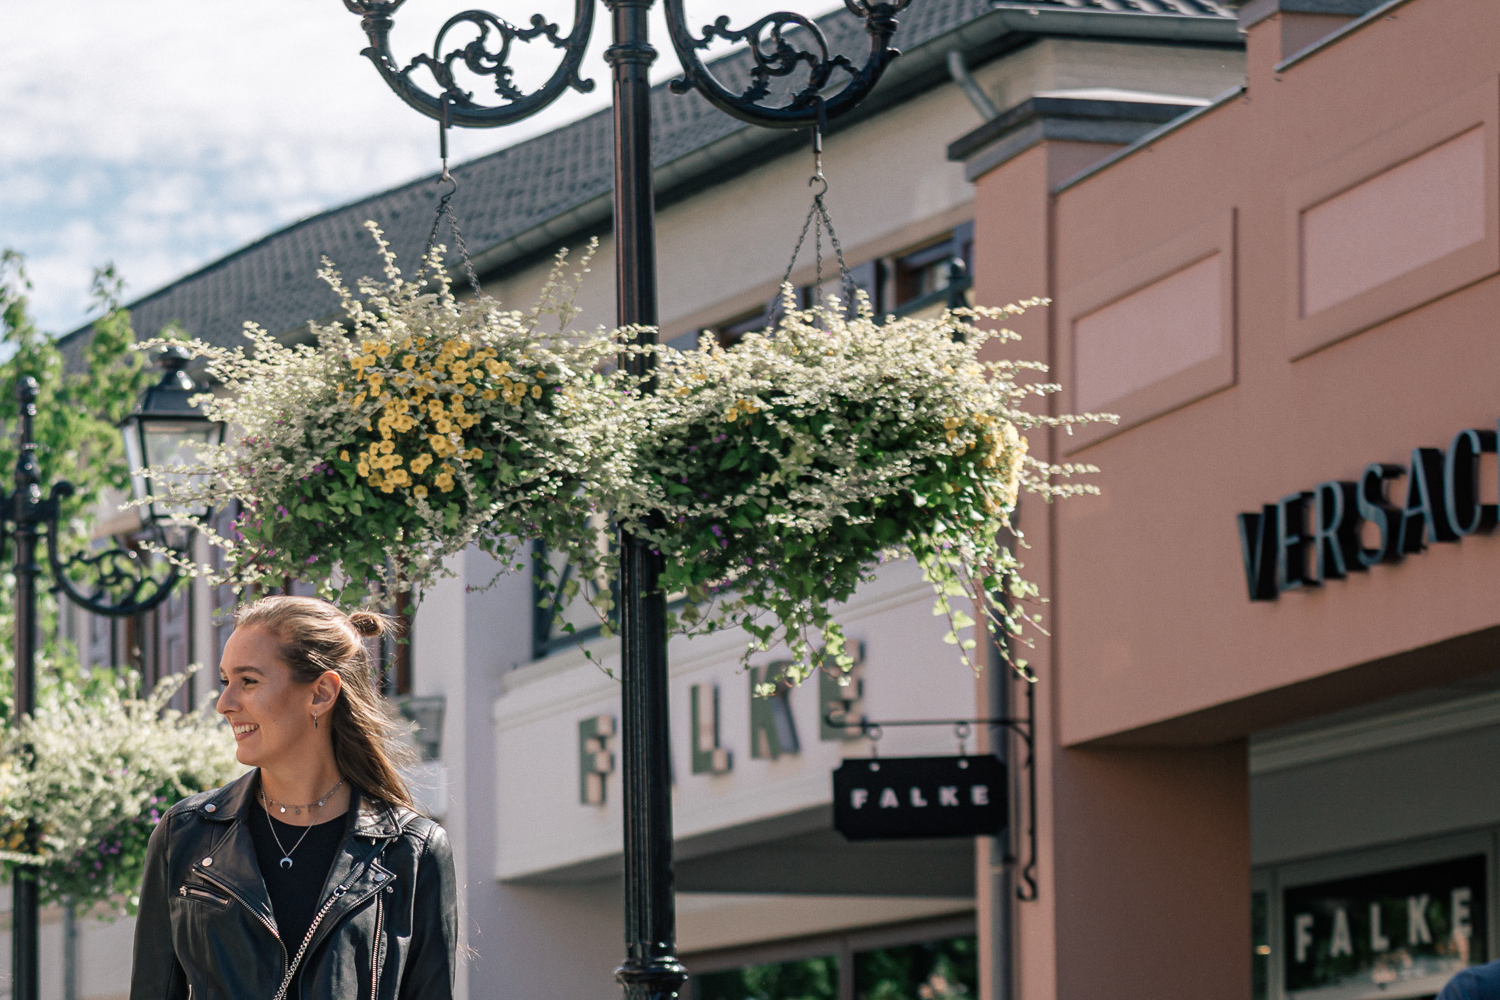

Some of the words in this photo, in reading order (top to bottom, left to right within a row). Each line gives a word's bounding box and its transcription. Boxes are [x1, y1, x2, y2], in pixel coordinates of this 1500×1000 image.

[1237, 418, 1500, 603] VERSAC
[579, 638, 864, 806] FLKE
[851, 785, 990, 810] FALKE
[1295, 887, 1472, 963] FALKE
